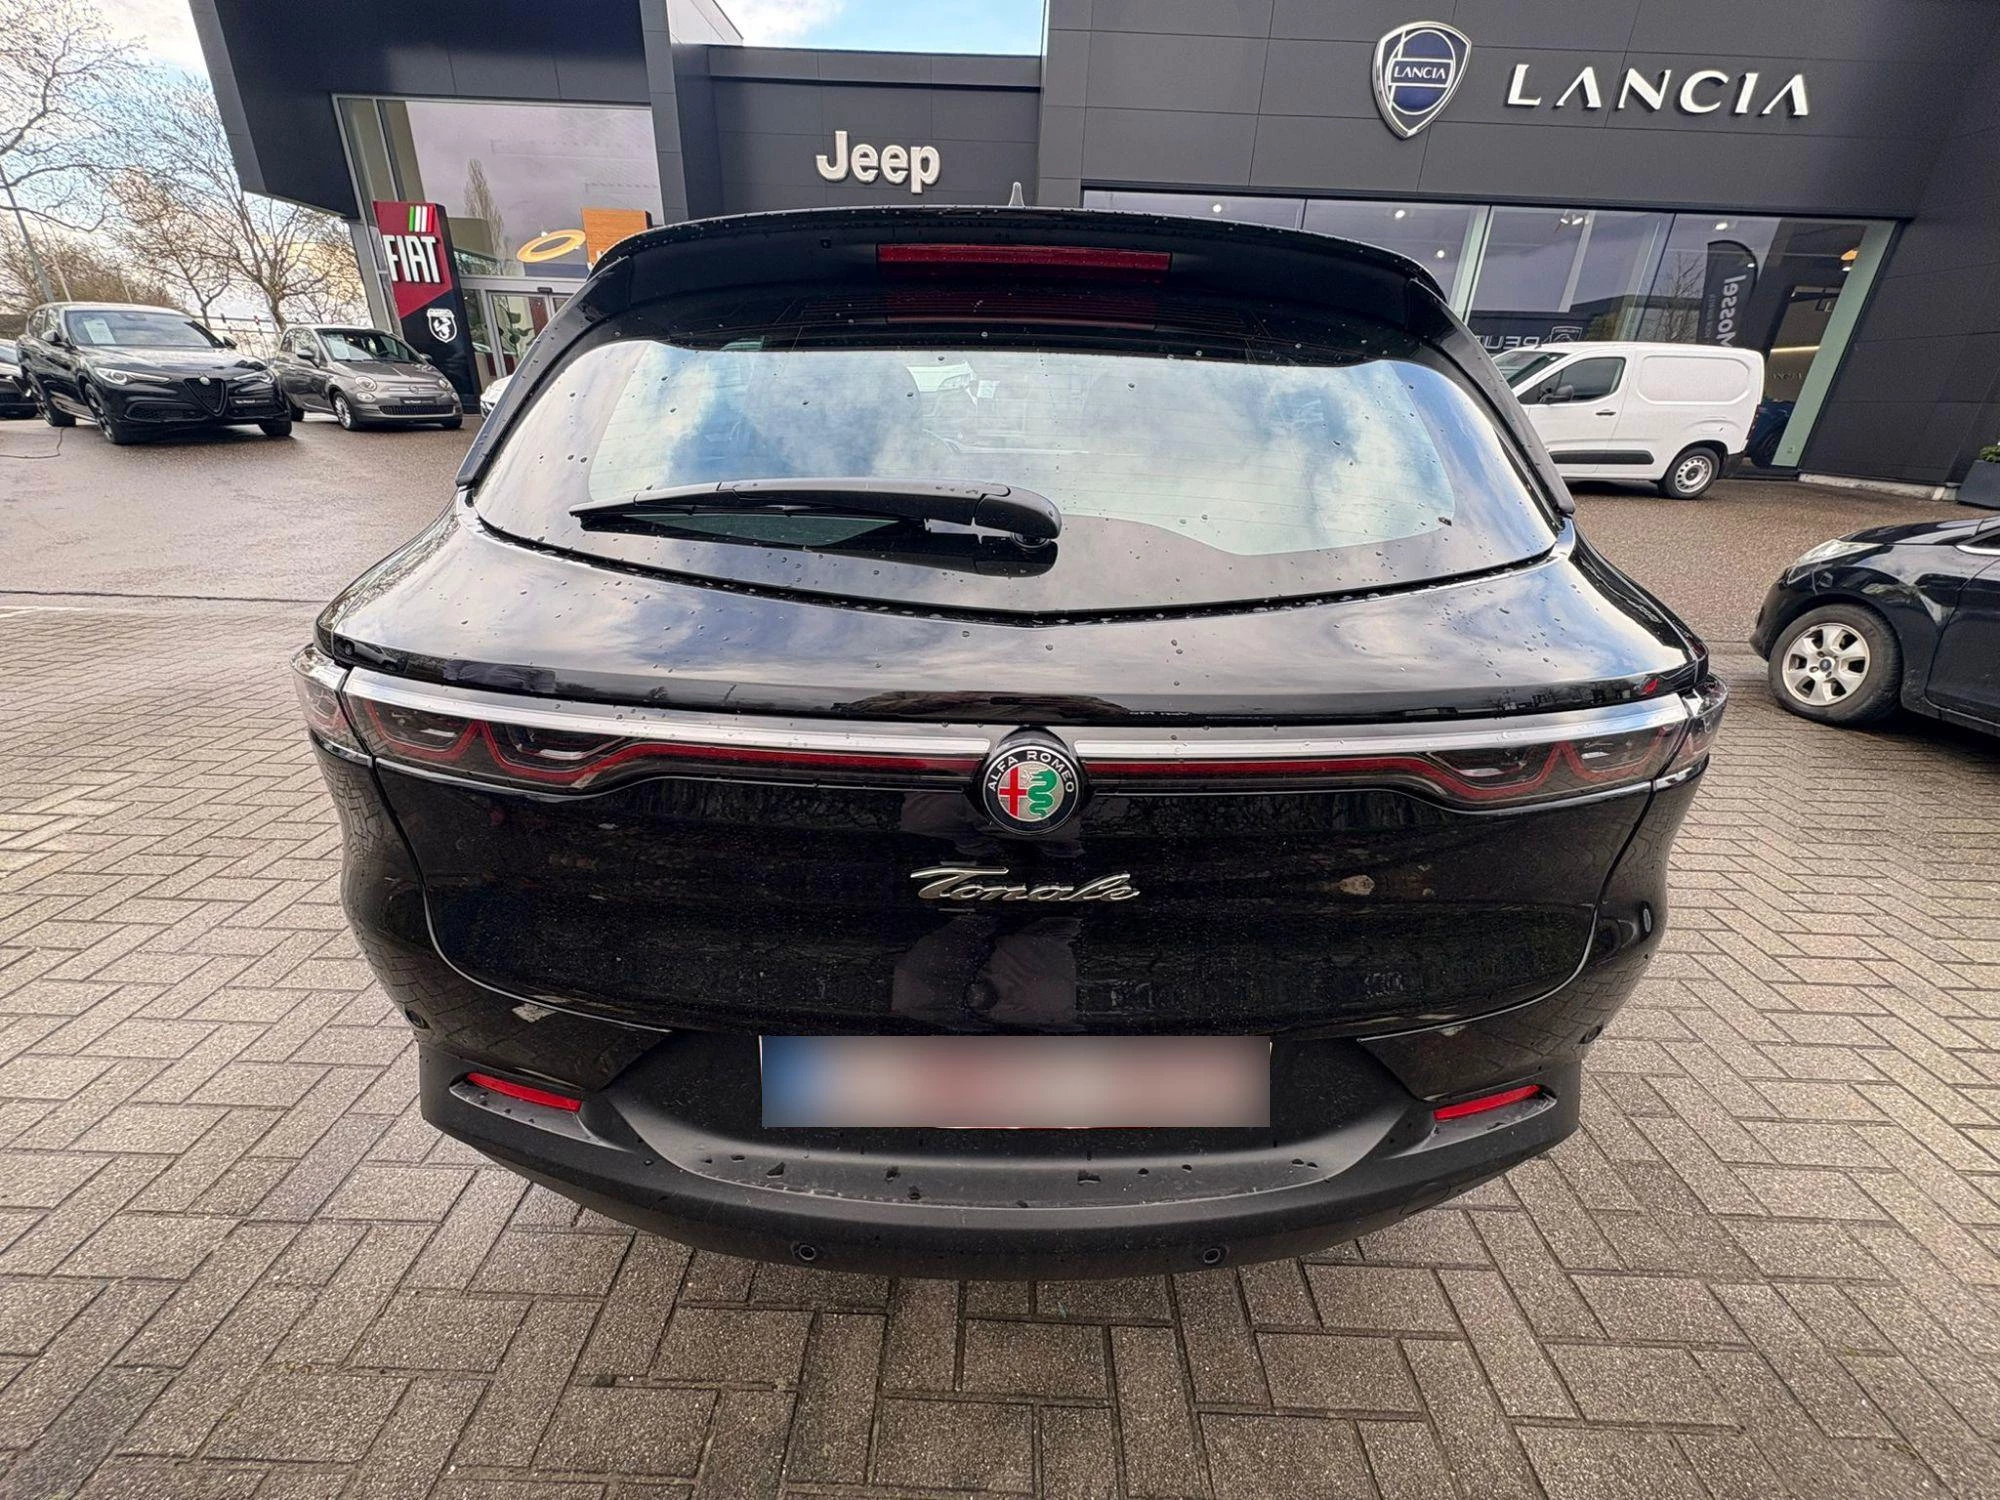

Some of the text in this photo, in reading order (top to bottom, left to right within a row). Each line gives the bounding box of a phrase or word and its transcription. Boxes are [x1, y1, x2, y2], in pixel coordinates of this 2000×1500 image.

[1393, 65, 1446, 80] LANCIA
[1506, 63, 1809, 117] LANCIA
[815, 130, 941, 194] Jeep
[382, 234, 441, 284] FIAT
[986, 749, 1076, 794] ALFA ROMEO
[910, 865, 1141, 901] Tonale
